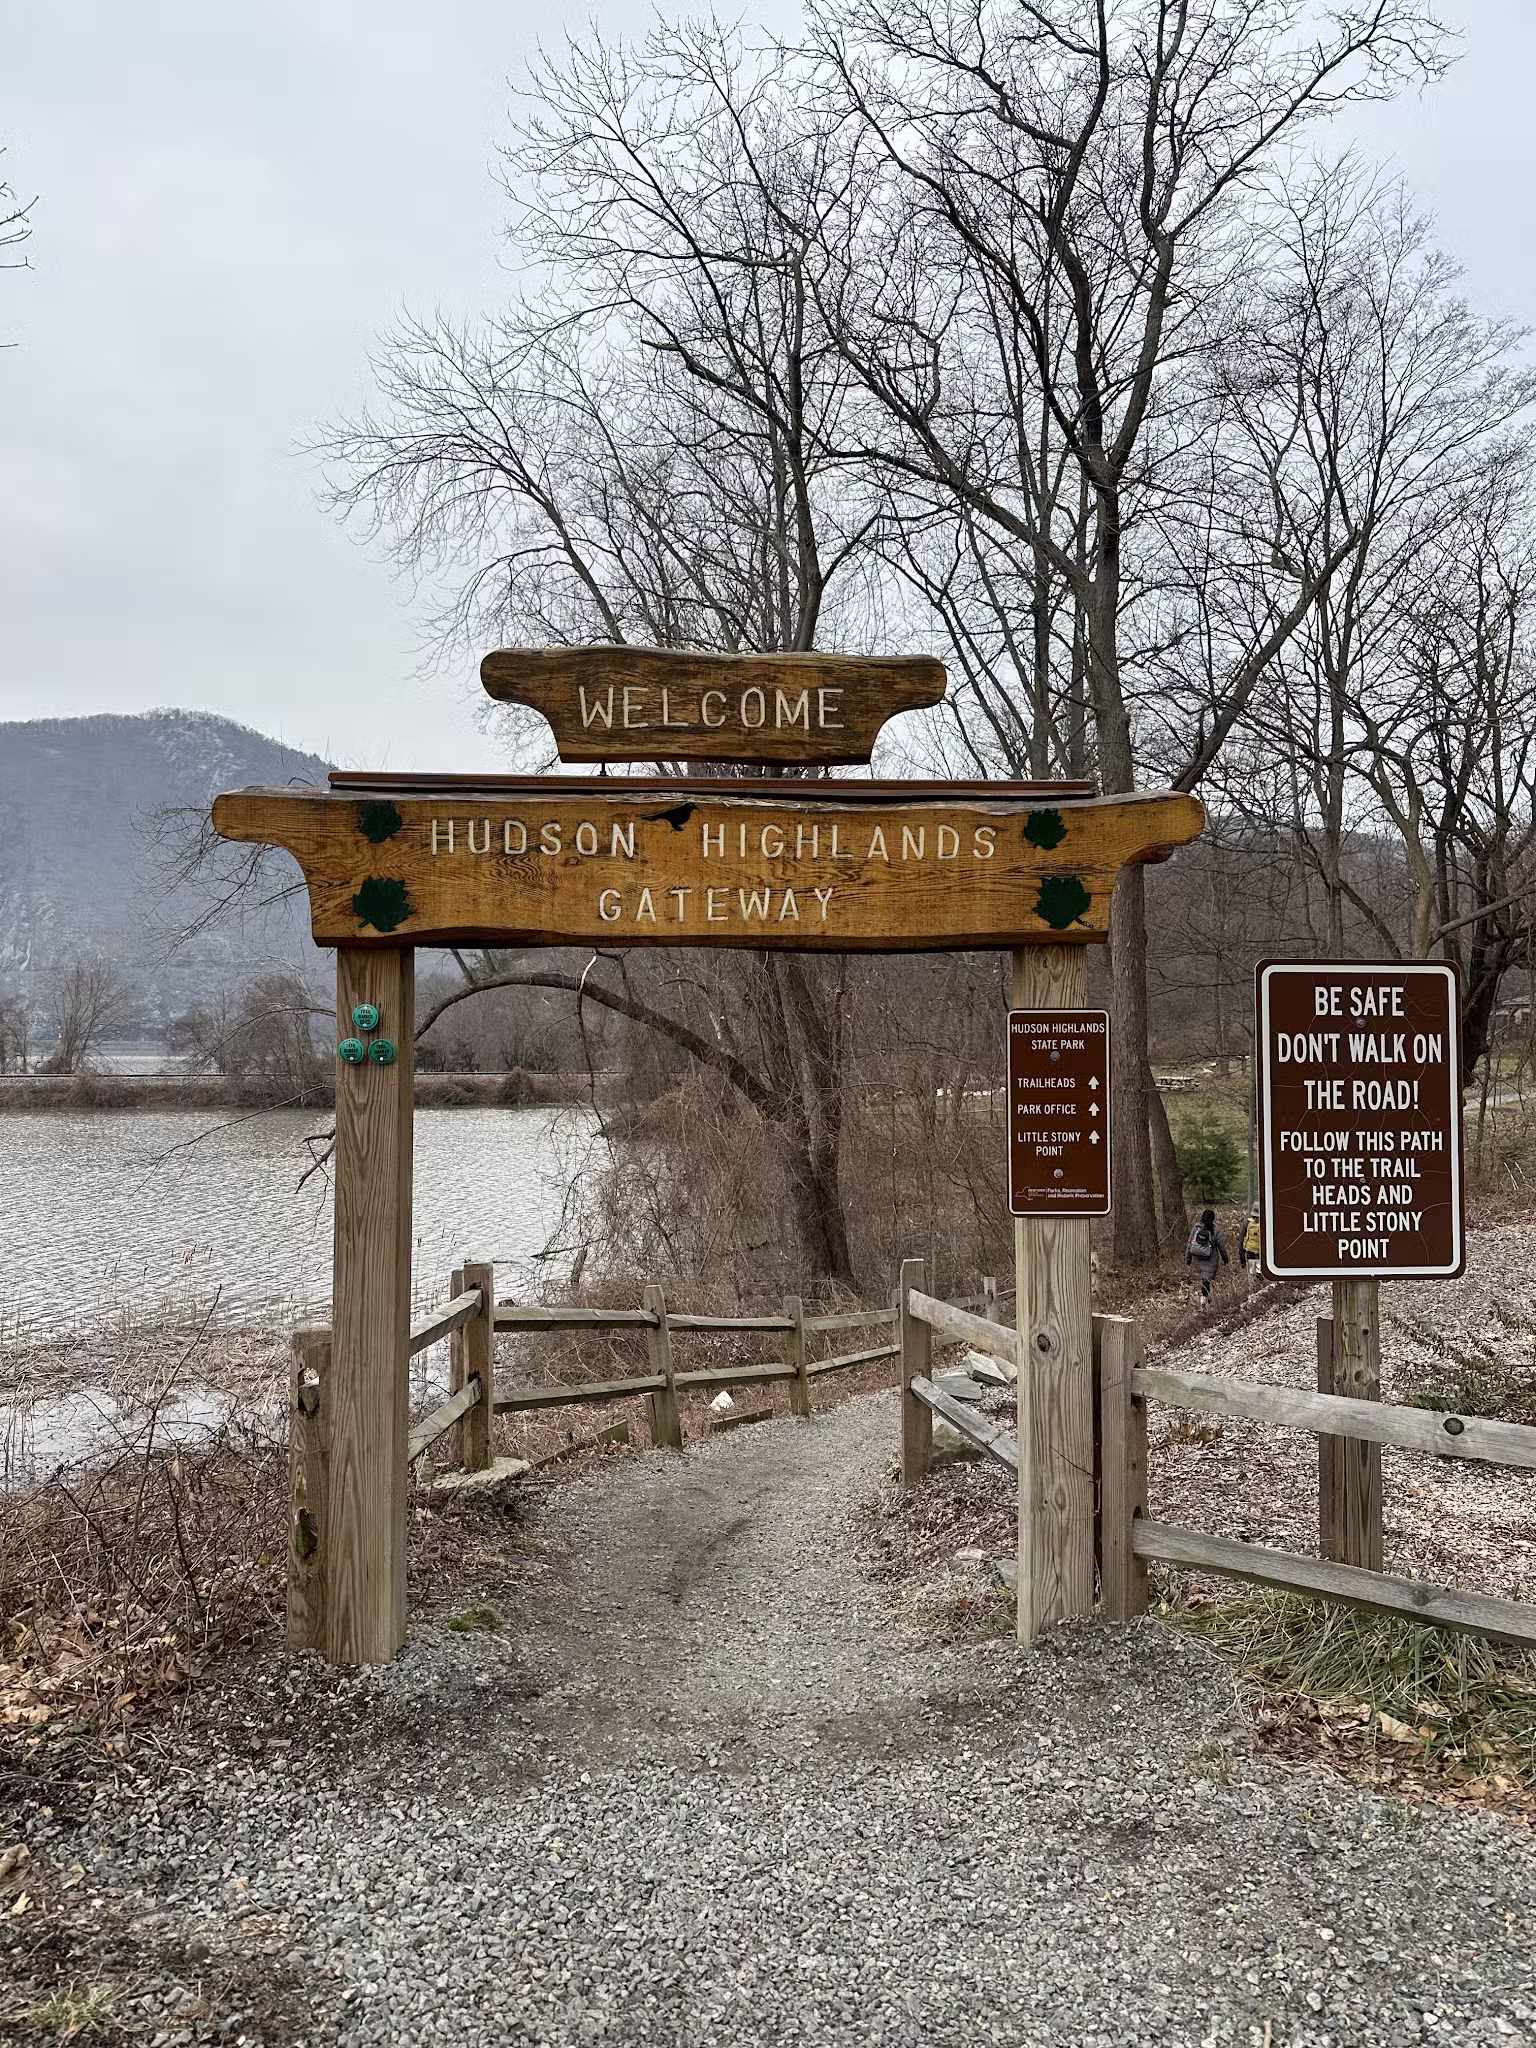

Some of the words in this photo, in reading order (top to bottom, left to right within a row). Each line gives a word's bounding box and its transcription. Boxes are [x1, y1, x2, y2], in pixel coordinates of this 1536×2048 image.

[578, 684, 845, 730] WELCOME
[431, 819, 635, 858] HUDSON
[702, 823, 996, 862] HIGHLANDS
[599, 887, 834, 922] GATEWAY
[1315, 987, 1342, 1015] BE
[1350, 987, 1404, 1016] SAFE
[1012, 1024, 1049, 1033] HUDSON
[1053, 1023, 1104, 1033] HIGHLANDS
[1032, 1040, 1057, 1049] STATE
[1061, 1040, 1084, 1049] PARK
[1278, 1033, 1340, 1063] DON'T
[1349, 1034, 1406, 1062] WALK
[1414, 1034, 1441, 1063] ON
[1018, 1078, 1075, 1088] TRAILHEADS
[1304, 1081, 1345, 1109] THE
[1353, 1081, 1418, 1110] ROAD!
[1018, 1105, 1041, 1114] PARK
[1044, 1104, 1076, 1114] OFFICE
[1018, 1132, 1048, 1142] LITTLE
[1051, 1132, 1080, 1142] STONY
[1281, 1132, 1349, 1151] FOLLOW
[1356, 1132, 1394, 1151] THIS
[1401, 1132, 1442, 1150] PATH
[1036, 1146, 1063, 1156] POINT
[1304, 1159, 1325, 1178] TO
[1331, 1159, 1364, 1178] THE
[1370, 1158, 1420, 1177] TRAIL
[1313, 1185, 1370, 1205] HEADS
[1377, 1185, 1412, 1204] AND
[1304, 1212, 1360, 1232] LITTLE
[1366, 1212, 1422, 1231] STONY
[1339, 1239, 1389, 1259] POINT
